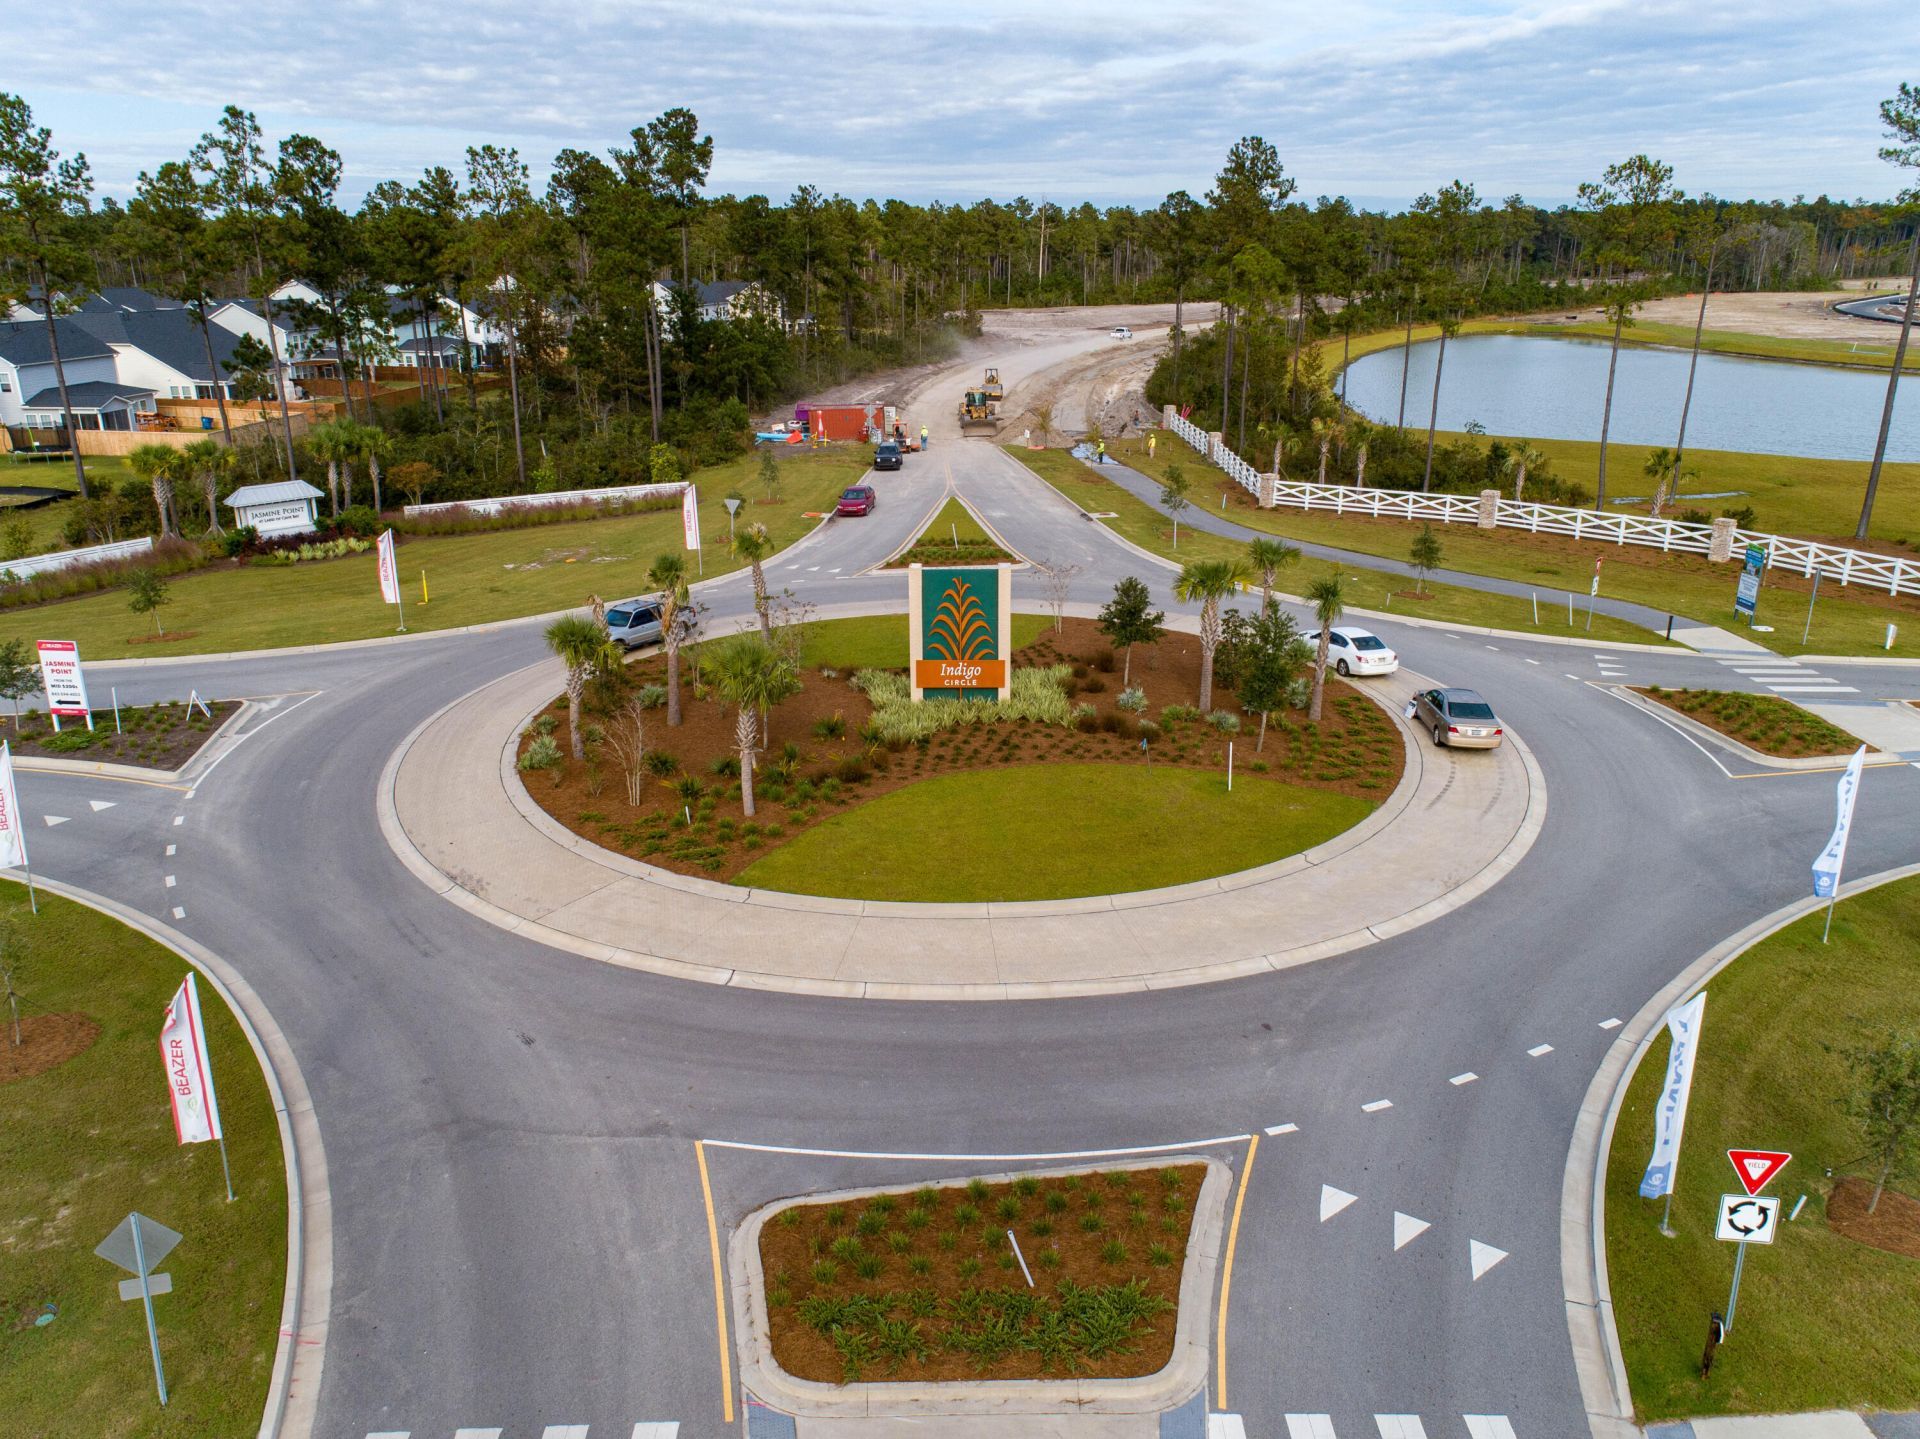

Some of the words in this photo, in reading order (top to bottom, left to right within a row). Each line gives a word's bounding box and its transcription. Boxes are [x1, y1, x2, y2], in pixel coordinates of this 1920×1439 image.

[251, 509, 281, 520] JASMINE
[282, 506, 304, 515] POINT
[940, 662, 982, 680] Indigo
[170, 1038, 192, 1097] BEAZER
